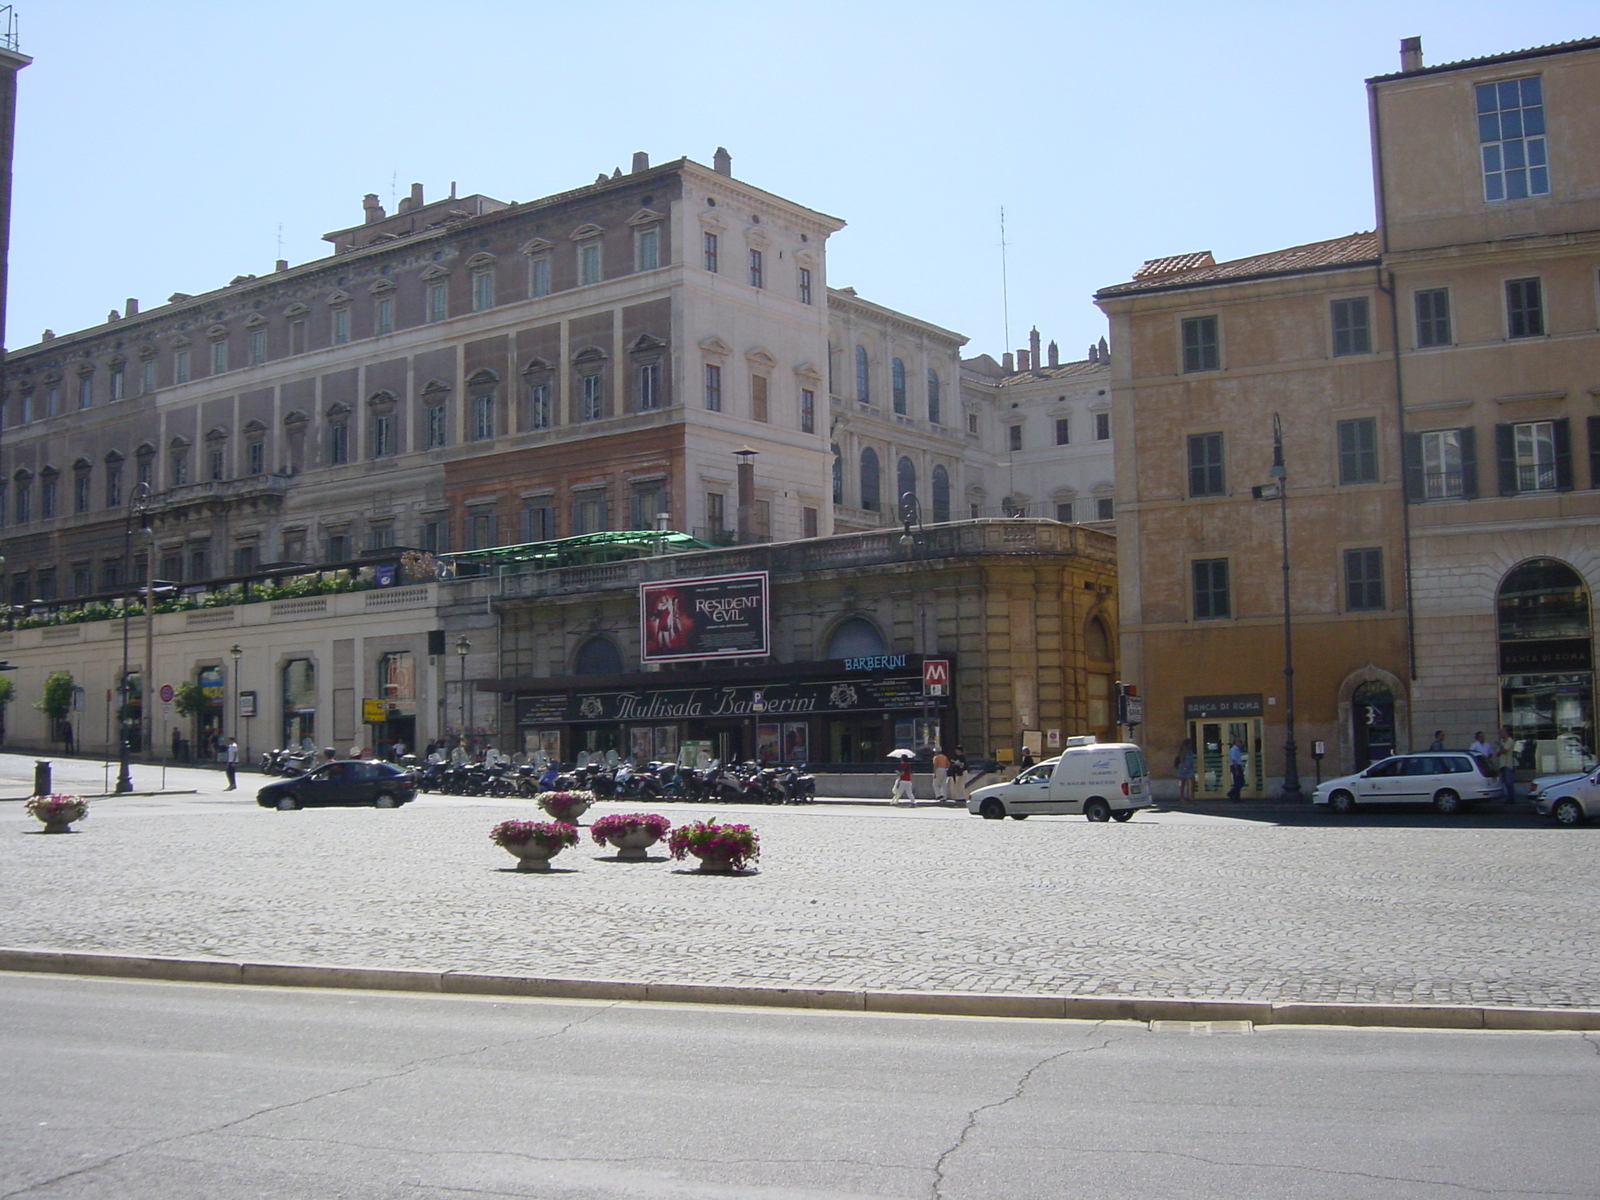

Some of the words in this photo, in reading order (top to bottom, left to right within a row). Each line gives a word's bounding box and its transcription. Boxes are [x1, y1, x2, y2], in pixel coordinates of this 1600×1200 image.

[713, 609, 744, 622] EVIL
[844, 654, 906, 671] BARBERINI
[926, 665, 946, 680] M
[613, 691, 702, 718] Multisala
[754, 692, 761, 703] P
[1232, 701, 1260, 710] ROMA
